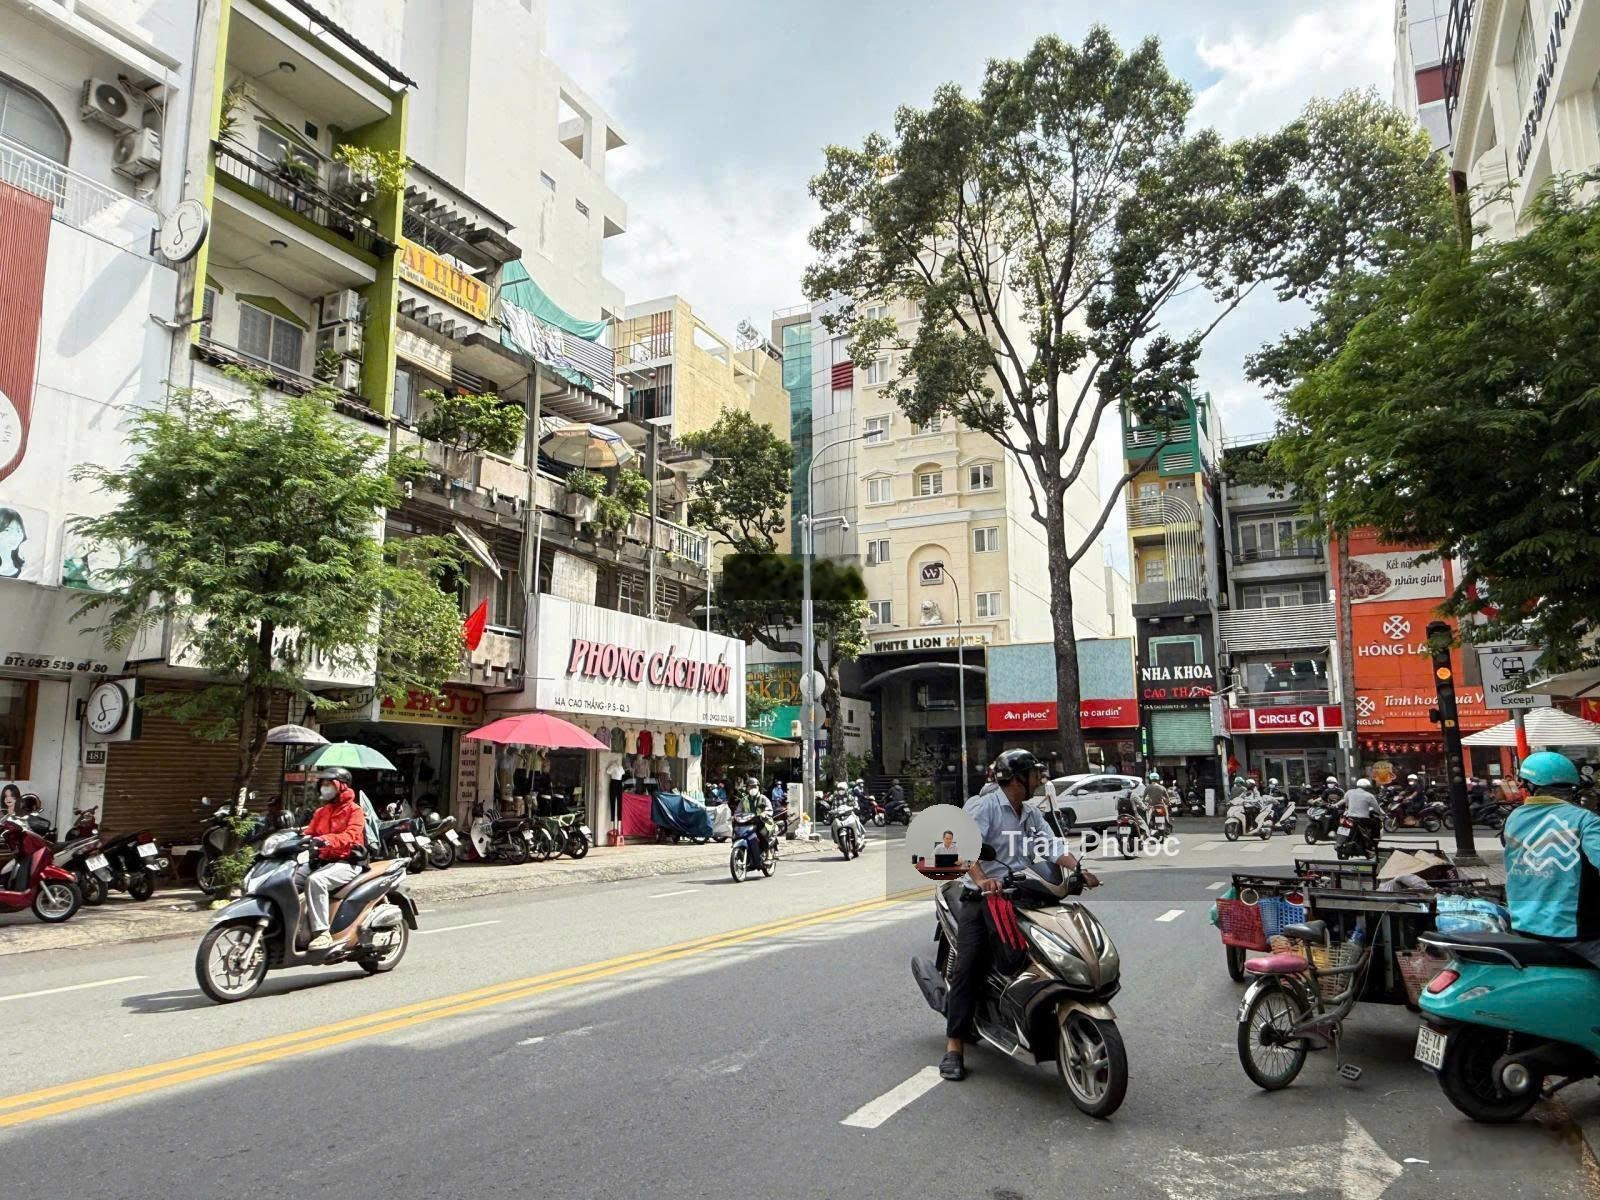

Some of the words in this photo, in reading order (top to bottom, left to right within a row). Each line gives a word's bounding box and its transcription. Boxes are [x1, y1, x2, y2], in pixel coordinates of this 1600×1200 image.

[1394, 574, 1418, 586] nhân
[1420, 573, 1442, 586] gian
[873, 640, 909, 652] WHITE
[912, 637, 941, 649] LION
[1407, 643, 1433, 655] LA
[28, 659, 50, 668] 093
[52, 660, 75, 670] 519
[566, 638, 645, 683] PHONG
[648, 645, 700, 691] CÁCH
[1141, 666, 1172, 681] NHA
[1173, 664, 1213, 680] KHOA
[1143, 687, 1167, 699] CAO
[568, 698, 583, 708] CAO
[1384, 695, 1408, 707] Tinh
[1500, 695, 1535, 706] Except
[1091, 708, 1120, 718] cardin
[1258, 714, 1298, 724] CIRCLE
[1300, 712, 1315, 725] K
[1356, 719, 1385, 727] NGLAM
[87, 751, 105, 761] 481
